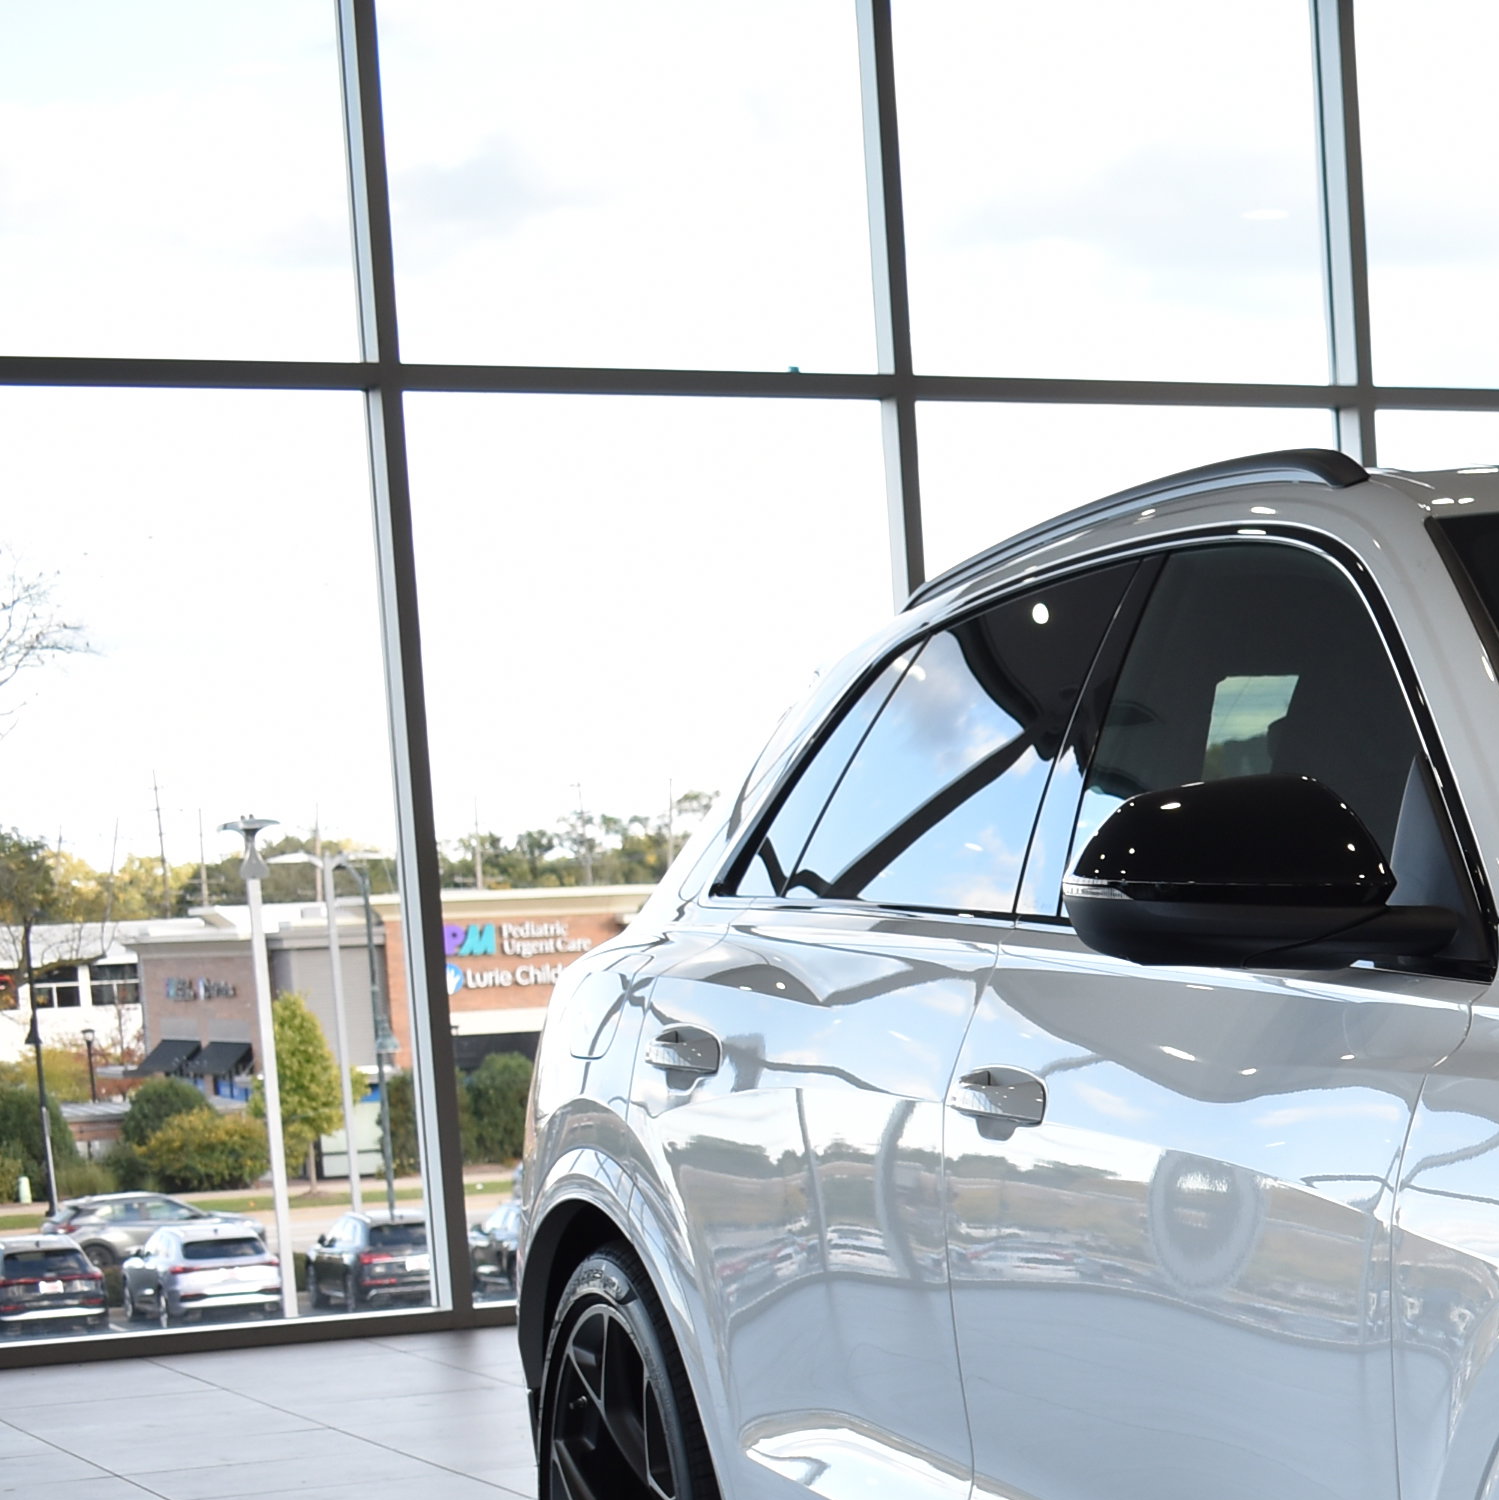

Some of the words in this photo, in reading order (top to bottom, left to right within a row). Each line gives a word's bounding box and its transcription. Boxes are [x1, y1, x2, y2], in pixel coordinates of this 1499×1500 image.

[502, 921, 569, 939] Pediatric
[503, 939, 555, 958] Urgent
[556, 937, 592, 952] Care
[466, 968, 512, 988] Lurie
